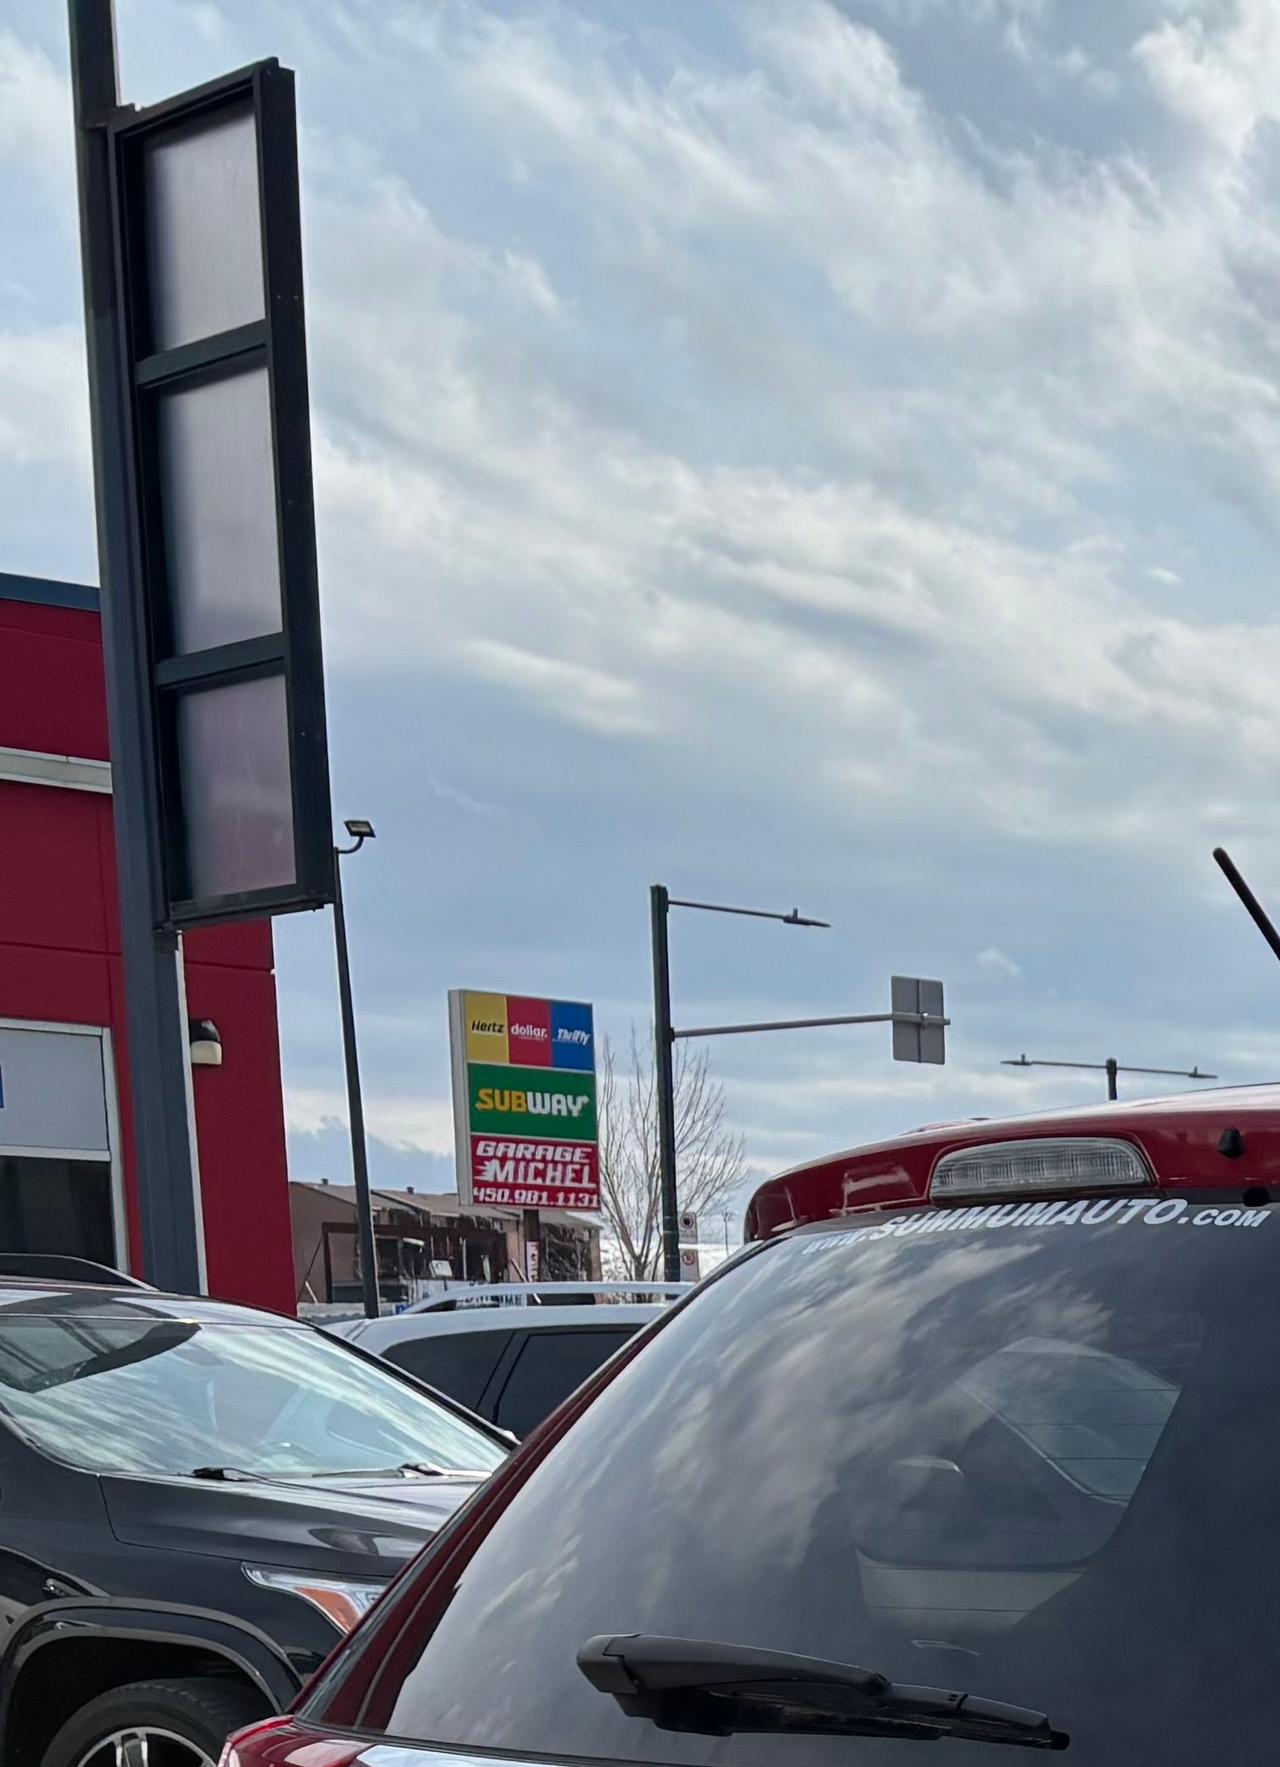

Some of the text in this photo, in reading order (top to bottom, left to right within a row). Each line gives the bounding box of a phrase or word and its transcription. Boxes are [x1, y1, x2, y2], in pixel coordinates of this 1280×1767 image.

[471, 1019, 505, 1034] Hertz
[476, 1088, 589, 1117] SUBWAY
[475, 1140, 593, 1163] GARAGE
[482, 1158, 597, 1189] MICHEL
